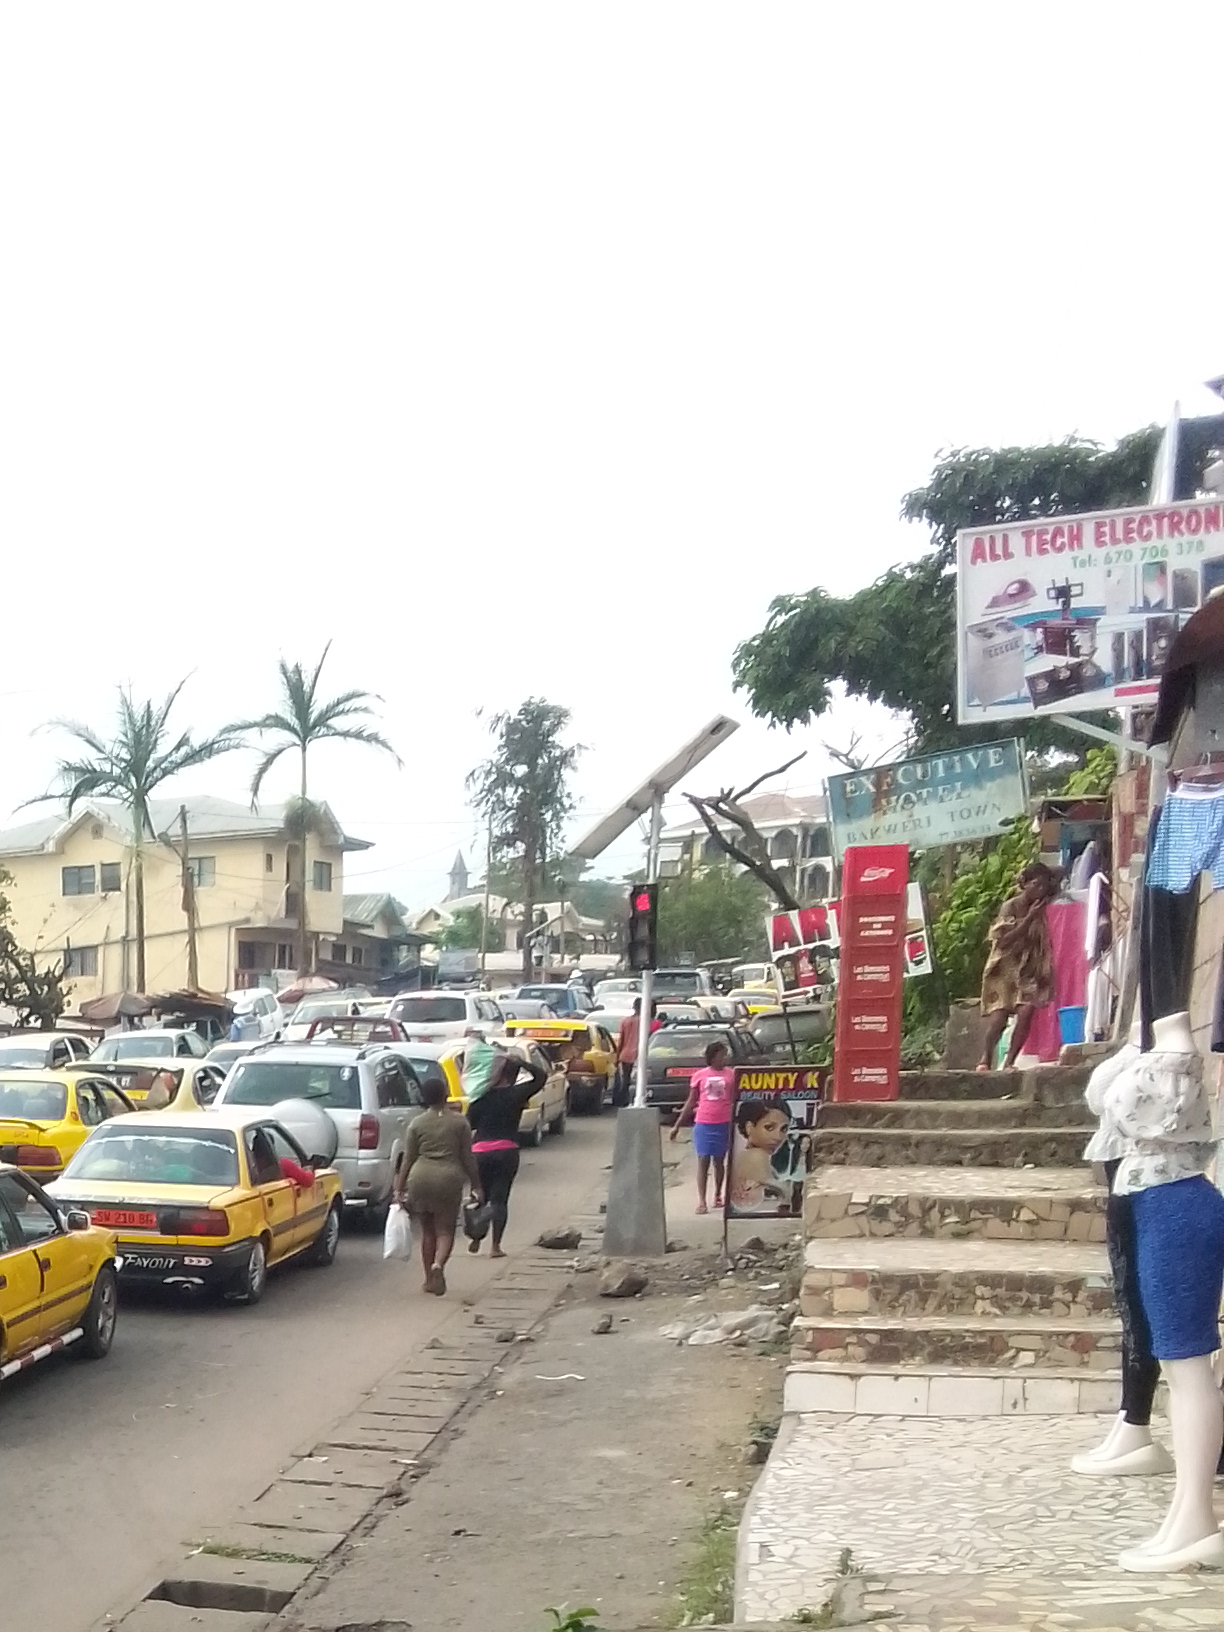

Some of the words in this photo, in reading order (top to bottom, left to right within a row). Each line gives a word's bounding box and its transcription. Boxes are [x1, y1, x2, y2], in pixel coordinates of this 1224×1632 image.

[970, 532, 1015, 566] ALL
[1021, 522, 1083, 557] TECH
[1094, 505, 1223, 549] ELECTRON
[1140, 543, 1170, 561] 706
[843, 747, 1005, 798] EXECUTIVE
[879, 781, 971, 817] HOTEL
[846, 815, 931, 844] BAKWERI
[947, 801, 1002, 823] TOWN
[738, 1072, 798, 1090] AUNTY
[740, 1090, 776, 1101] BEAUTY
[780, 1090, 818, 1100] SALOON
